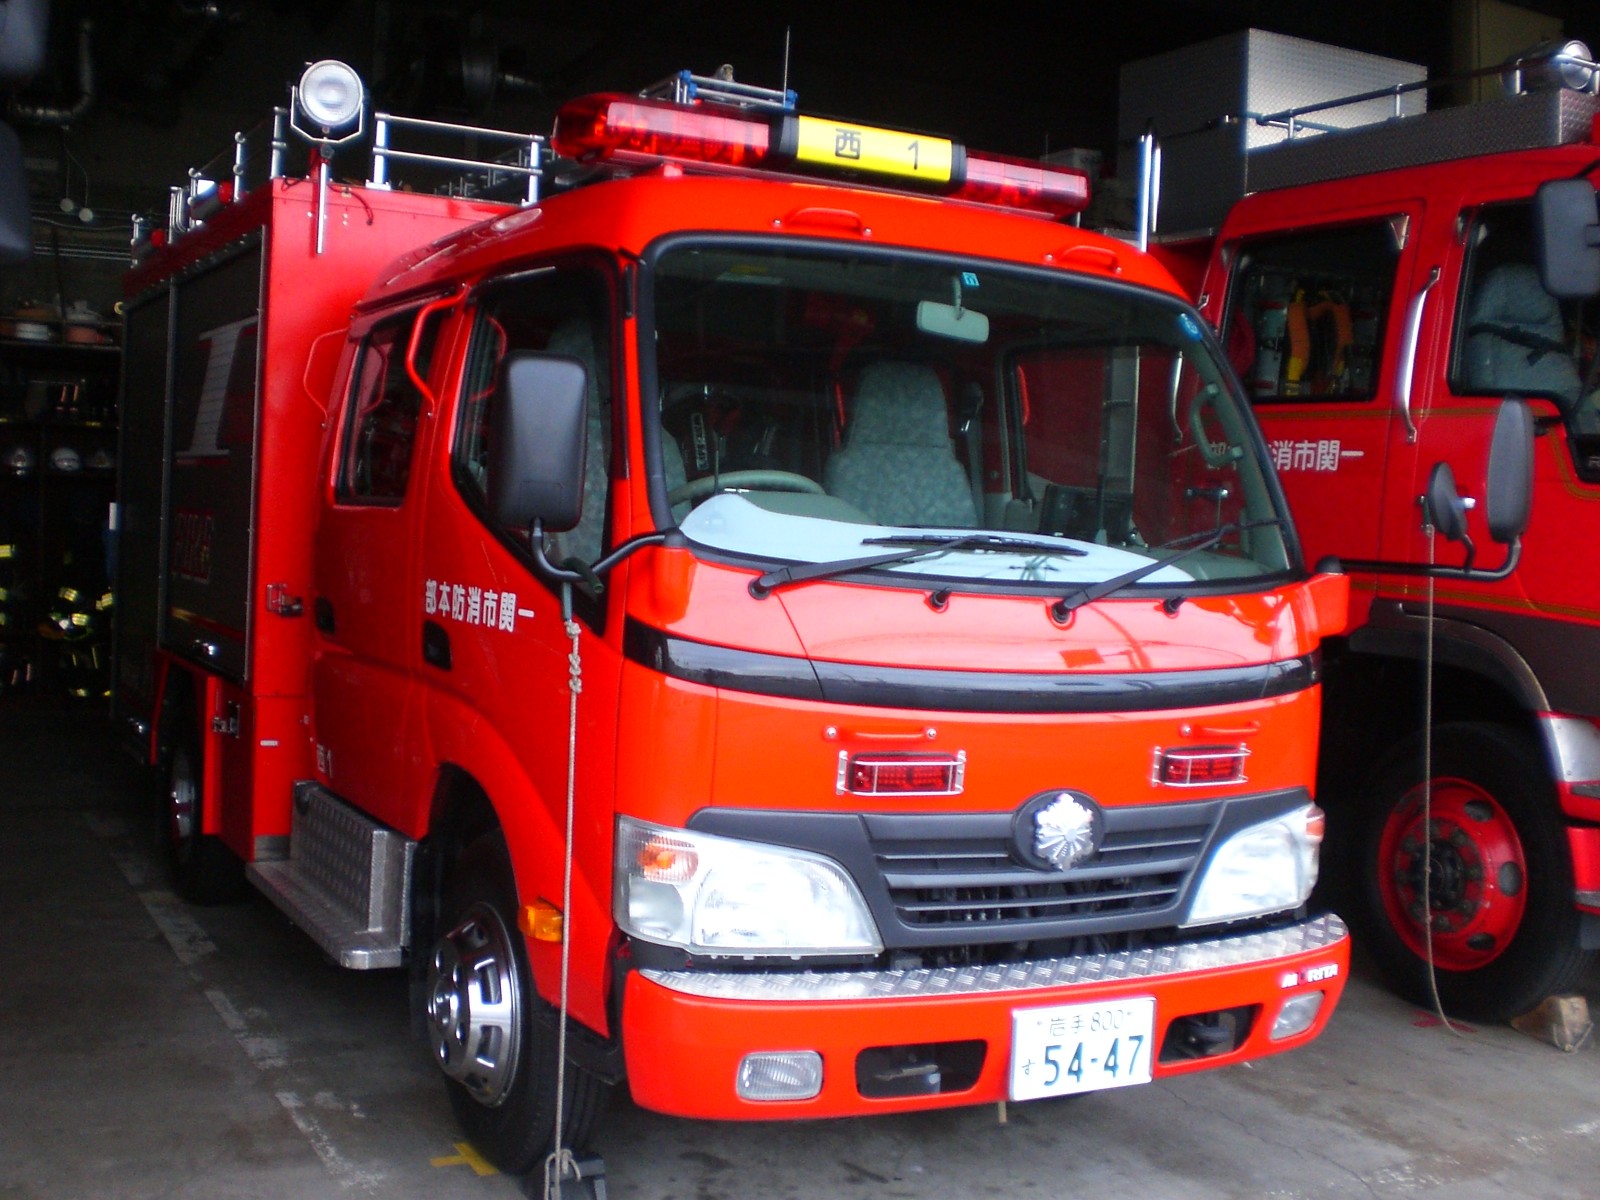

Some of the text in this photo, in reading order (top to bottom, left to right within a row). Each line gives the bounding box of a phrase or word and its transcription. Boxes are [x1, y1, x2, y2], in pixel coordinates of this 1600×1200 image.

[835, 128, 919, 170] 西 1
[1044, 1035, 1144, 1086] 54-47
